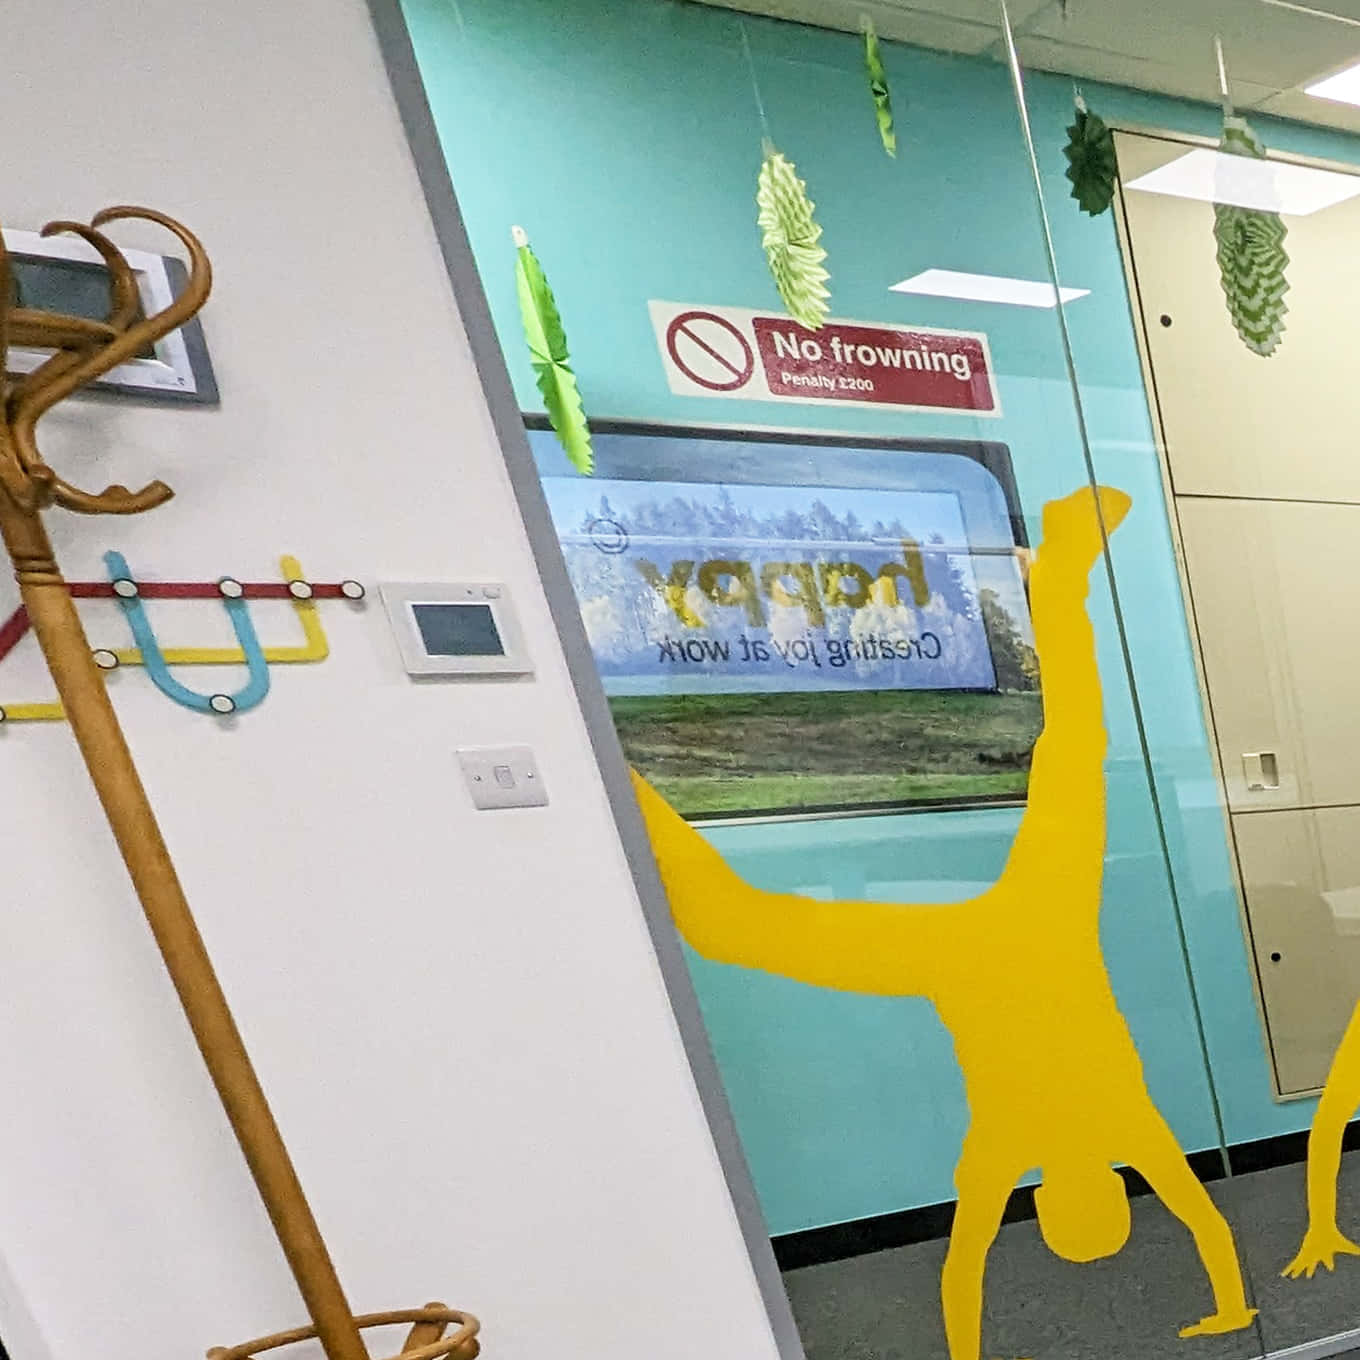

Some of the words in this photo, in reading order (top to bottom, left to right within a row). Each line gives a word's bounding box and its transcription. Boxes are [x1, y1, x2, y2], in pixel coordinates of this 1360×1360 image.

[771, 330, 823, 362] No
[829, 336, 972, 381] frowning
[780, 371, 836, 392] Penalty
[838, 376, 875, 392] £200
